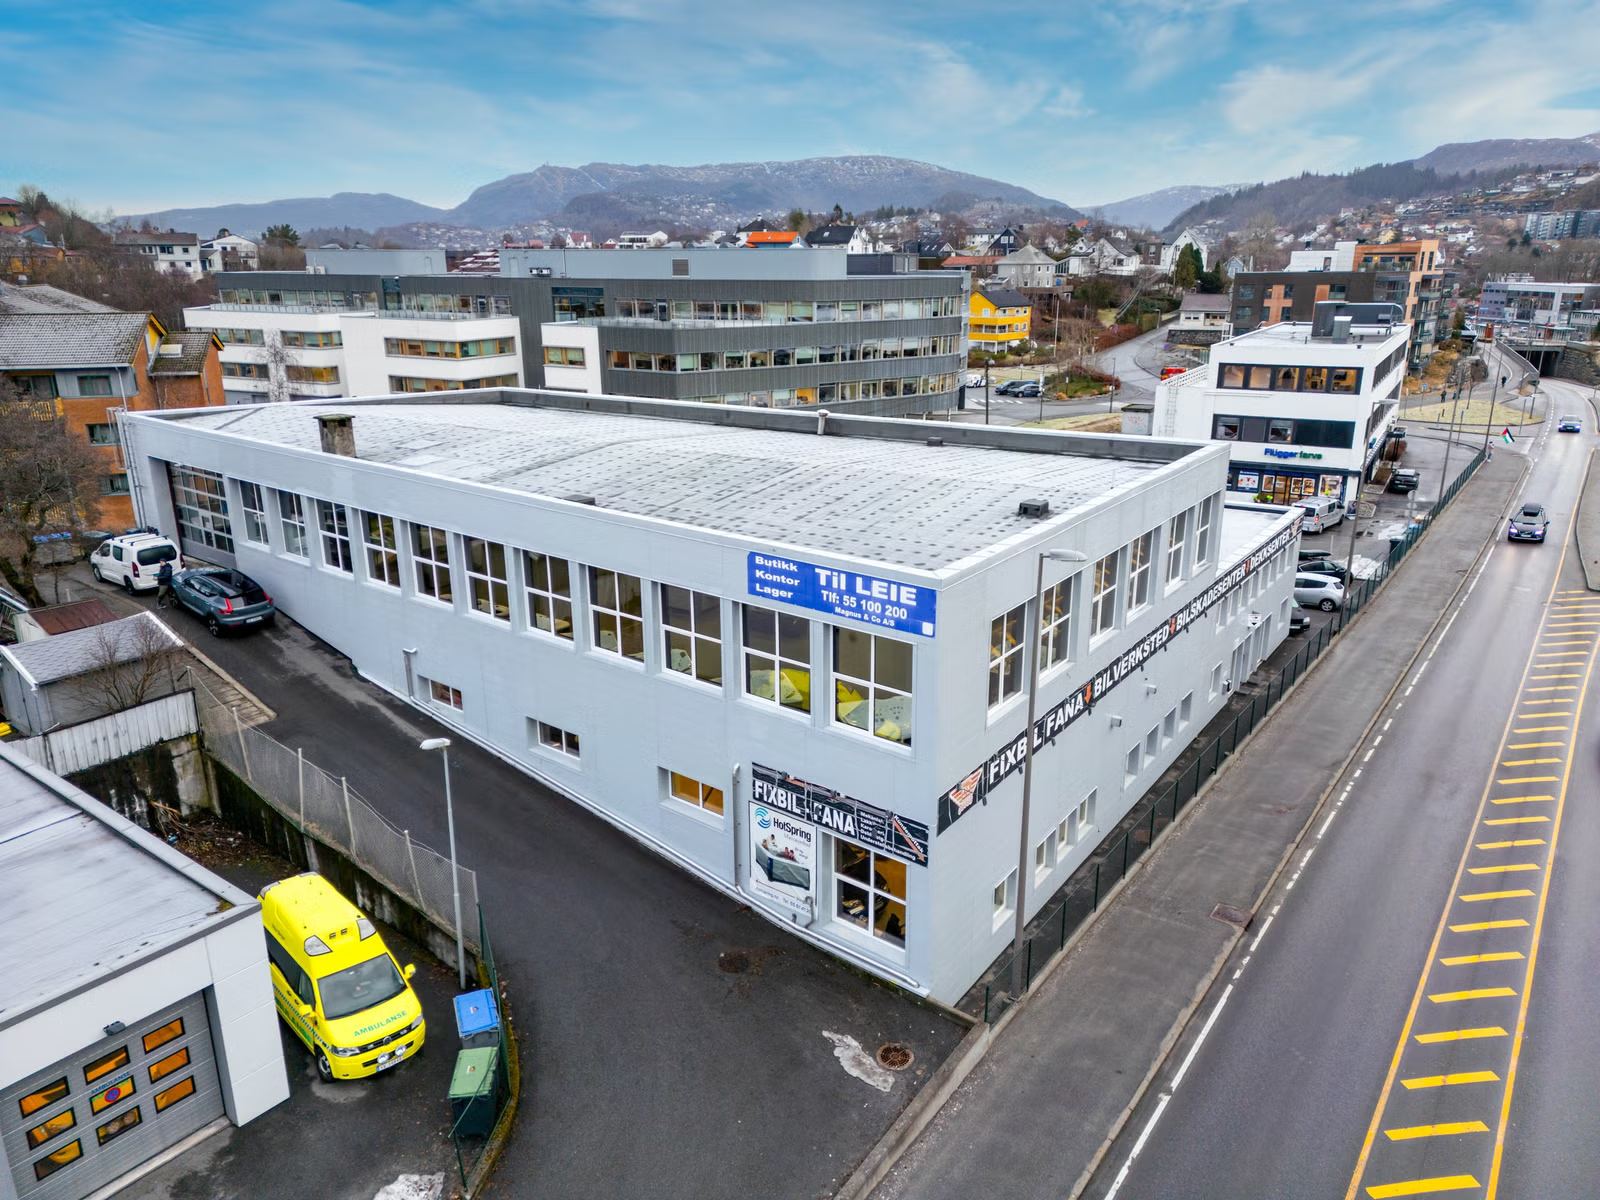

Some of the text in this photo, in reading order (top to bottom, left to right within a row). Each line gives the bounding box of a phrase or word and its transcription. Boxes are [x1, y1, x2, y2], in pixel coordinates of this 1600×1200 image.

[755, 555, 798, 572] Butikk
[755, 569, 800, 586] Kontor
[815, 567, 917, 606] Til LEIE
[755, 583, 793, 599] Lager
[821, 589, 907, 619] Tlf: 55 100 200
[834, 605, 862, 619] Magnus
[863, 613, 869, 621] &
[871, 615, 881, 624] Co
[989, 727, 1042, 785] FIXBL
[1046, 692, 1084, 736] FANA
[1094, 625, 1170, 699] BILVERKSTED
[1176, 565, 1246, 630] BILSKADESENTER
[755, 779, 800, 814] FIXBIL
[773, 817, 812, 842] HotSpring
[354, 1009, 408, 1037] AMBULANSE
